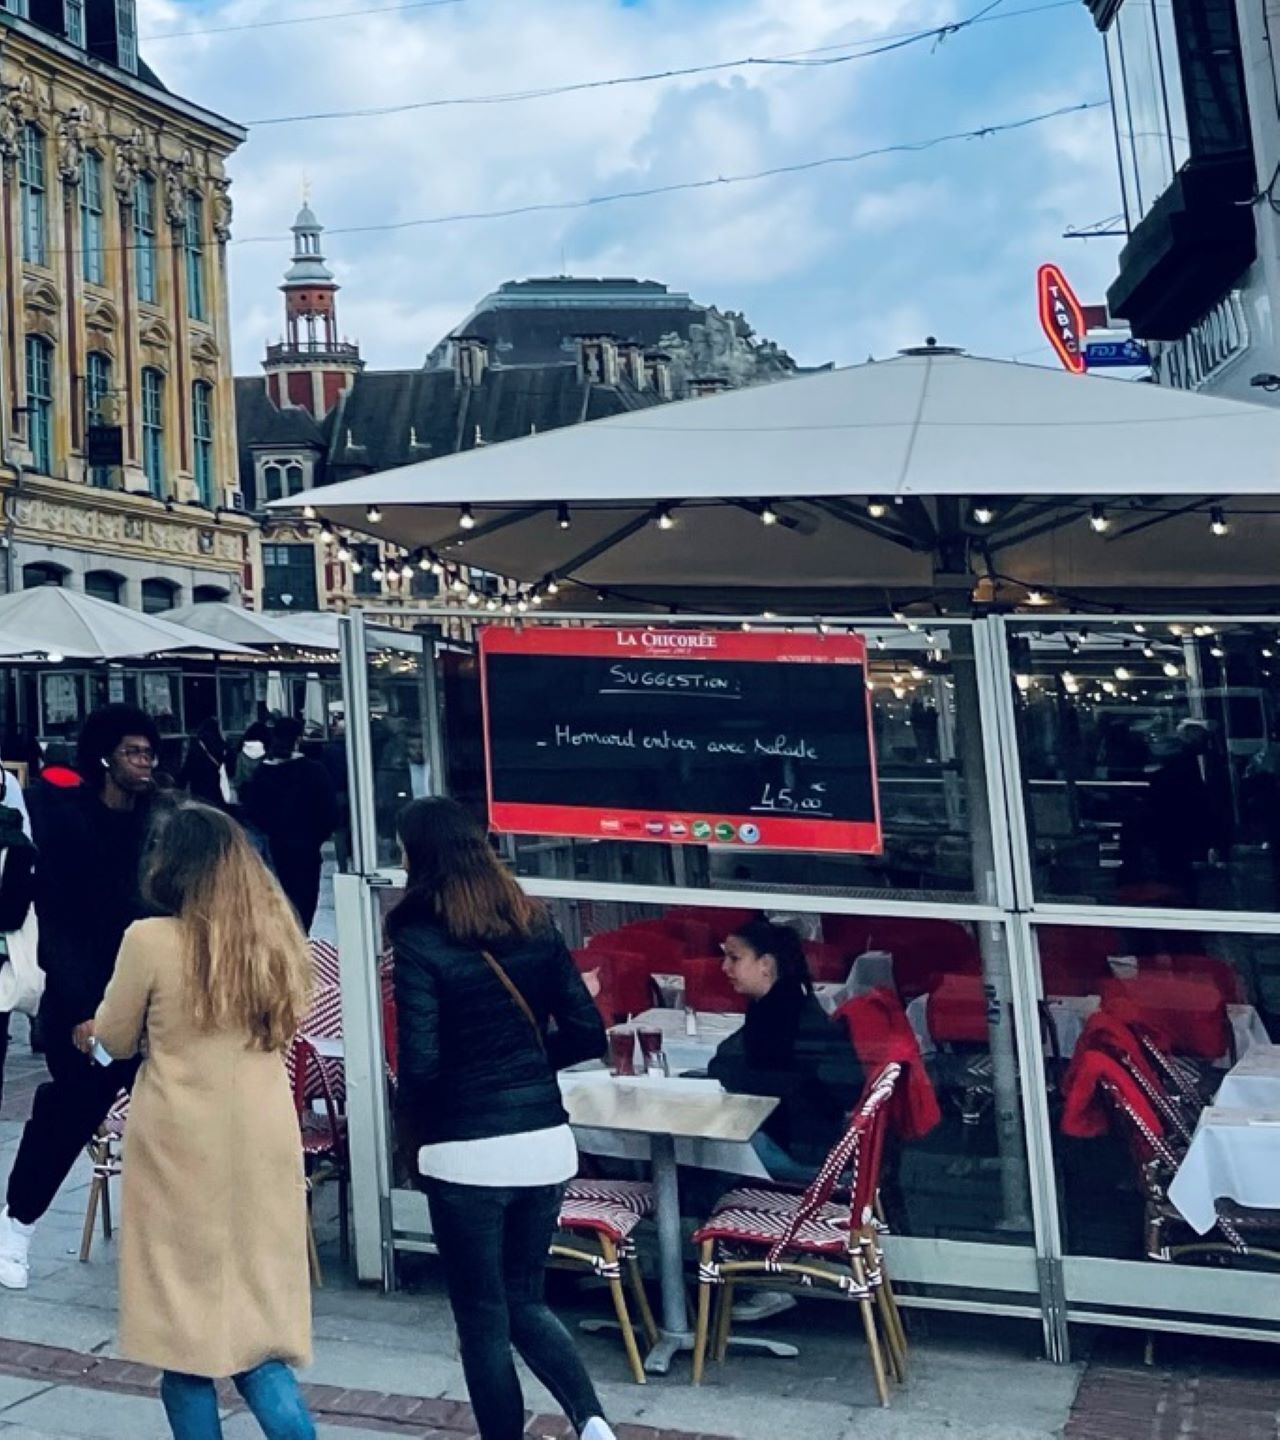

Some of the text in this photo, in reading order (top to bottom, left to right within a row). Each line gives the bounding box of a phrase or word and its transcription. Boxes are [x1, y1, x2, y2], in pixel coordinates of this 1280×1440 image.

[1048, 286, 1077, 353] TABAC
[1090, 346, 1117, 358] FDJ
[555, 724, 635, 748] Homard
[643, 730, 697, 750] entier
[707, 741, 746, 754] avec
[754, 734, 818, 760] salade
